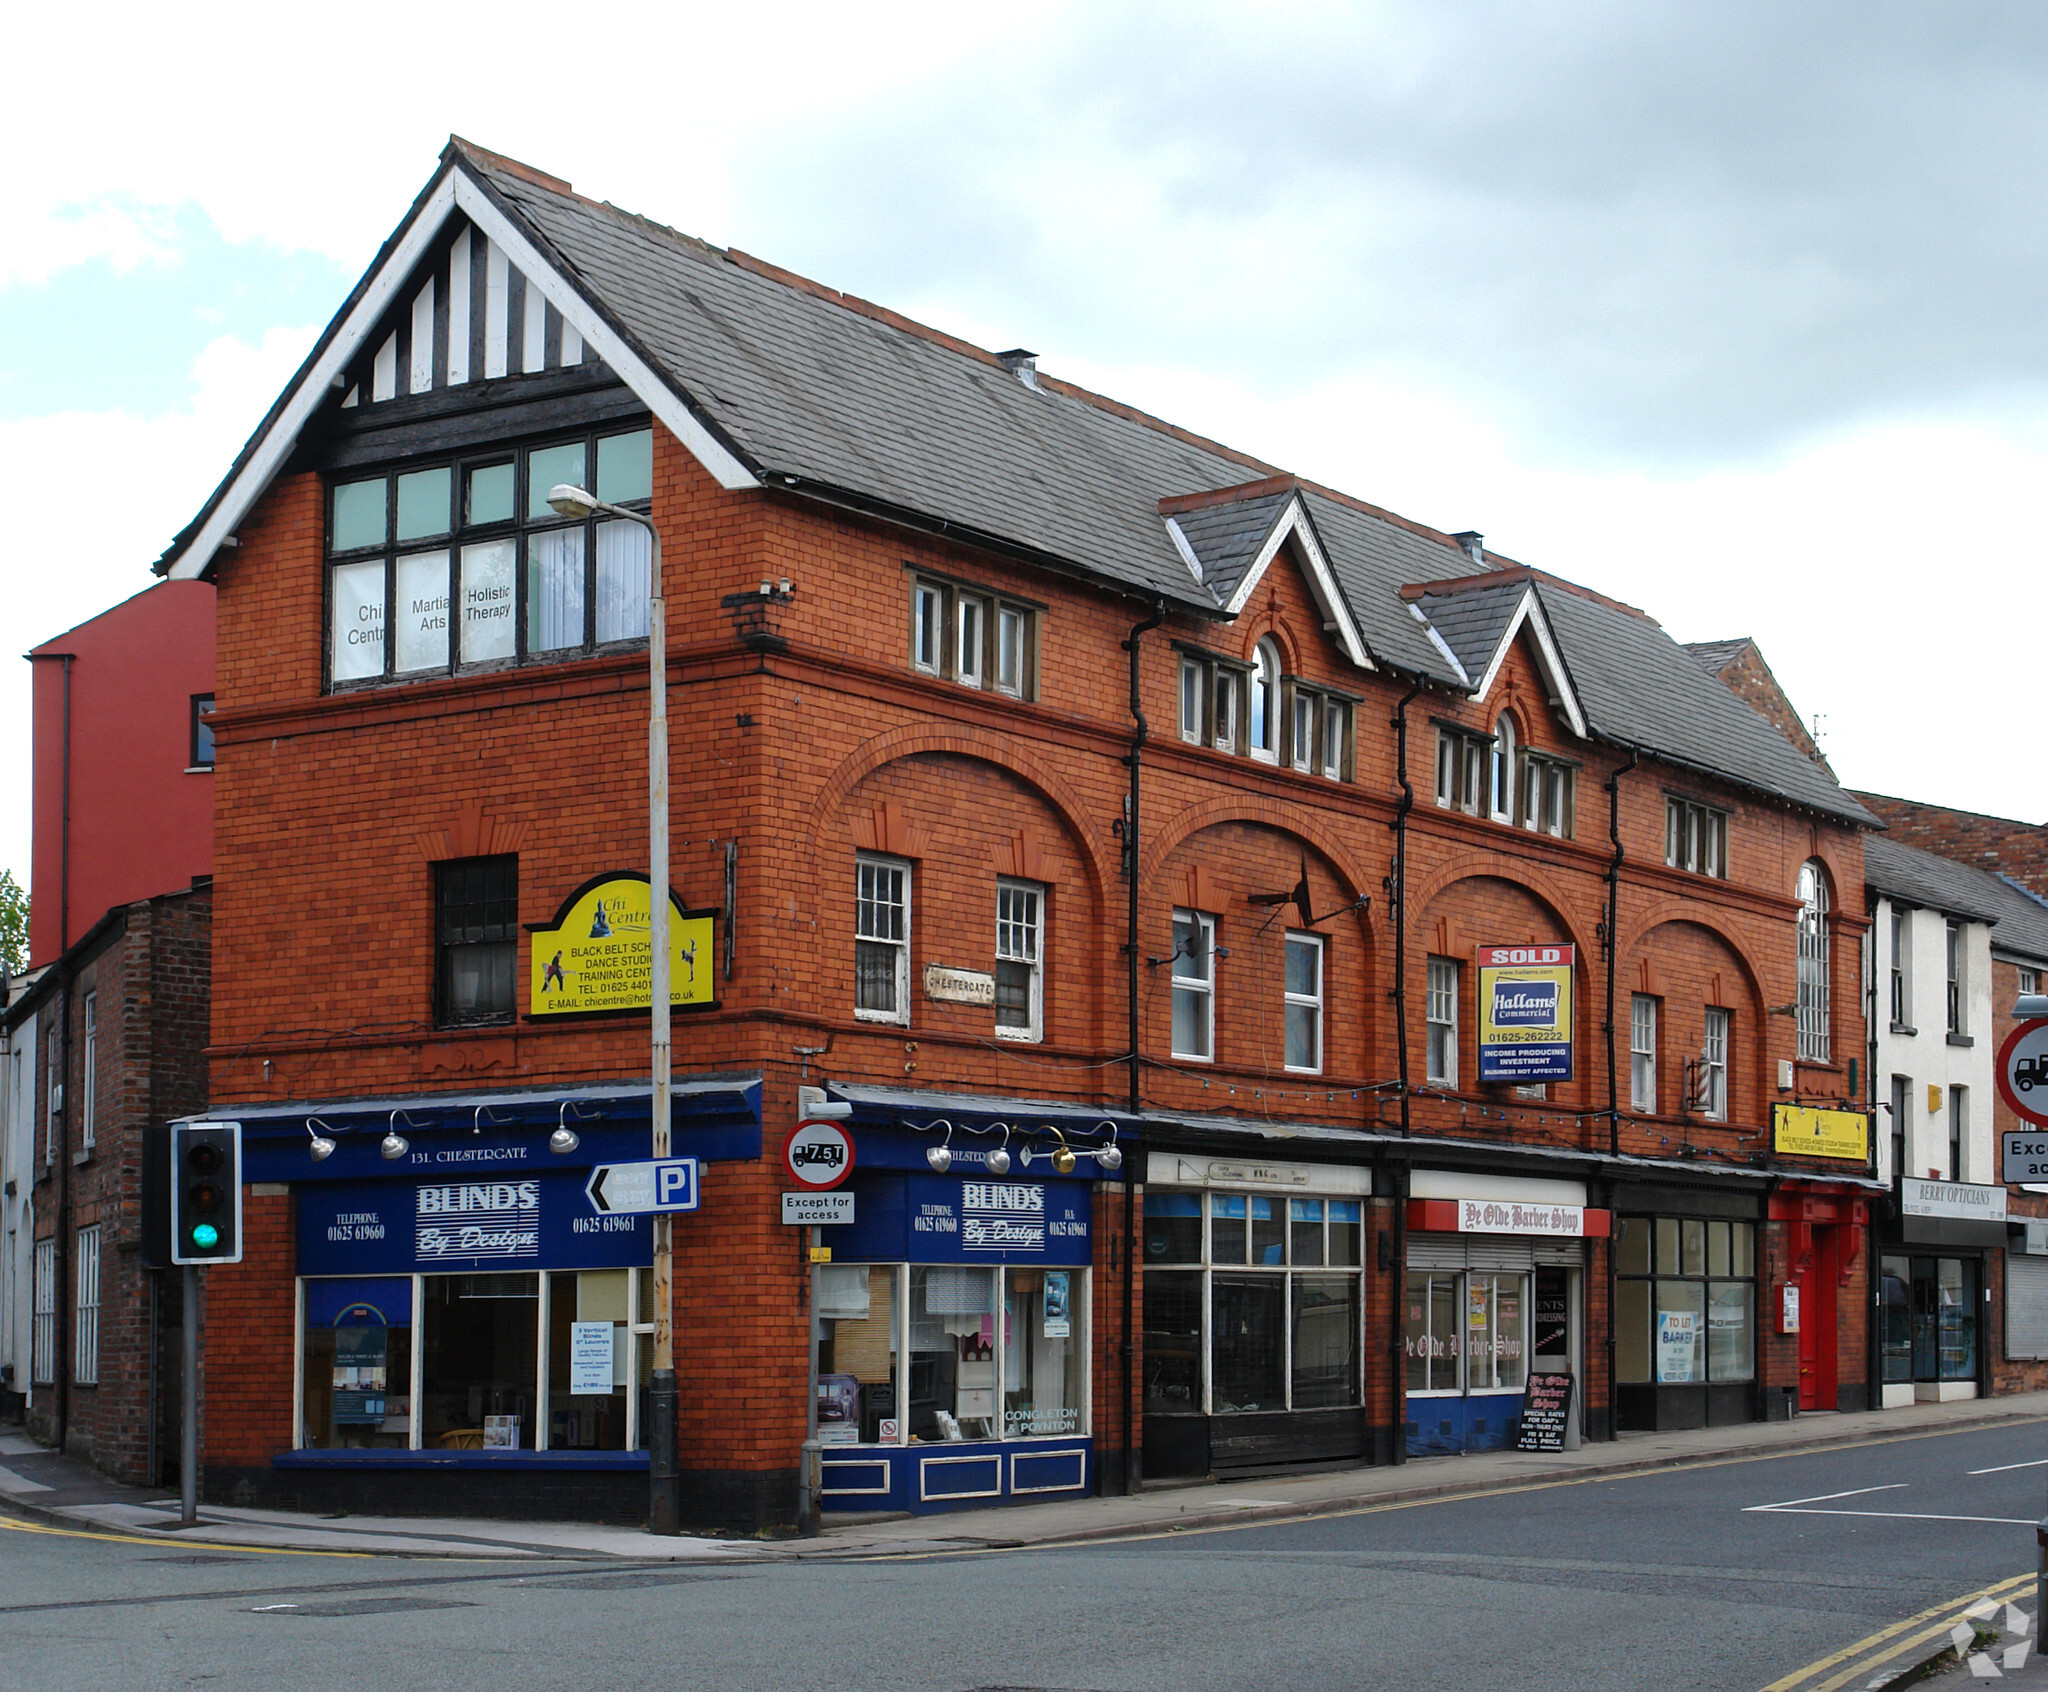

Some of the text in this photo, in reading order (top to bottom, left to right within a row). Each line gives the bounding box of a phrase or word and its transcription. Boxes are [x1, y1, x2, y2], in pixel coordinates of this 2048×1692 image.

[468, 585, 510, 602] Holistic
[412, 596, 450, 614] Martia
[466, 603, 511, 621] Therapy
[358, 604, 382, 622] Chi
[420, 616, 446, 631] Arts
[348, 627, 384, 645] Centr
[604, 896, 626, 911] Chi
[571, 942, 651, 958] BLACK BELT SCH
[1491, 949, 1560, 964] SOLD
[586, 957, 618, 968] DANCE
[578, 968, 652, 982] TRAINING CENT
[578, 980, 652, 994] TEL: 01625 4401
[548, 998, 582, 1010] E-MAIL:
[1494, 994, 1556, 1010] Hallams
[1499, 1009, 1550, 1018] Commercial
[1489, 1032, 1562, 1042] 01625-262222
[436, 1147, 528, 1162] CHESTERGATE
[2011, 1140, 2048, 1155] Exc
[660, 1166, 686, 1203] P
[419, 1182, 538, 1213] BLINDS
[786, 1197, 849, 1208] Except for
[964, 1184, 1043, 1210] BLINDS
[1920, 1184, 1990, 1206] BERRY OPTICIANS
[336, 1213, 380, 1224] TELEPHONE:
[798, 1211, 840, 1220] access
[1466, 1202, 1578, 1232] Ye Olde Barber Shop
[573, 1216, 635, 1233] 01625 619661
[914, 1216, 958, 1232] 01625 619660
[1050, 1222, 1087, 1236] 01625 619661
[328, 1224, 384, 1241] 01625 619660
[964, 1220, 1042, 1246] By Design
[419, 1226, 535, 1255] By Design
[1536, 1300, 1564, 1310] ENTS
[1668, 1317, 1692, 1328] TO LET
[1662, 1331, 1693, 1344] BARKER
[1530, 1386, 1566, 1398] Barber
[1532, 1398, 1560, 1410] Shop
[1005, 1408, 1078, 1420] CONGLETON
[1008, 1420, 1075, 1433] & POYNTON
